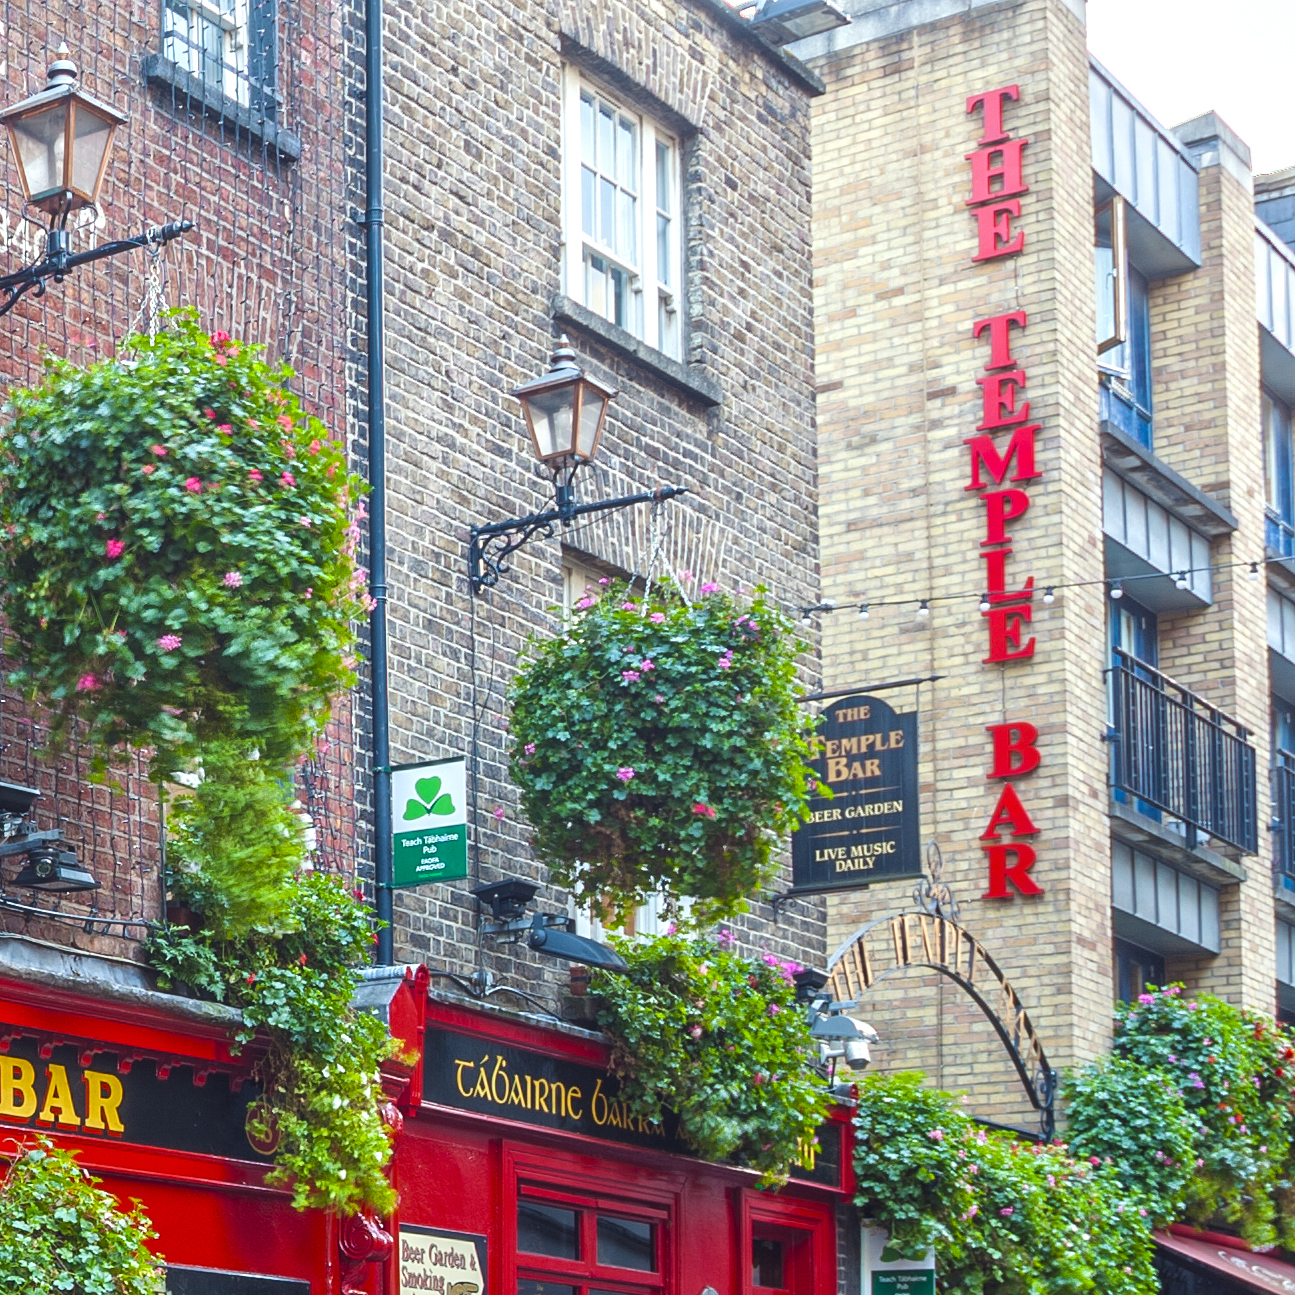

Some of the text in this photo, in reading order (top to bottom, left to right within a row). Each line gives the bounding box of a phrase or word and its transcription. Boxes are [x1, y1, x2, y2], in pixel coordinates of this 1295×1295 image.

[966, 84, 1030, 262] THE
[964, 309, 1044, 666] TEMPLE
[836, 705, 871, 724] THE
[807, 729, 905, 761] TEMPLE
[826, 756, 883, 784] BAR
[845, 800, 904, 820] GARDEN
[981, 721, 1046, 901] BAR
[402, 837, 422, 847] Teach
[422, 846, 437, 854] Pub
[815, 840, 897, 863] LIVE MUSIC
[835, 856, 877, 873] DAILY
[401, 1238, 426, 1264] Beer
[428, 1243, 467, 1270] Garden
[401, 1265, 446, 1295] Smoking
